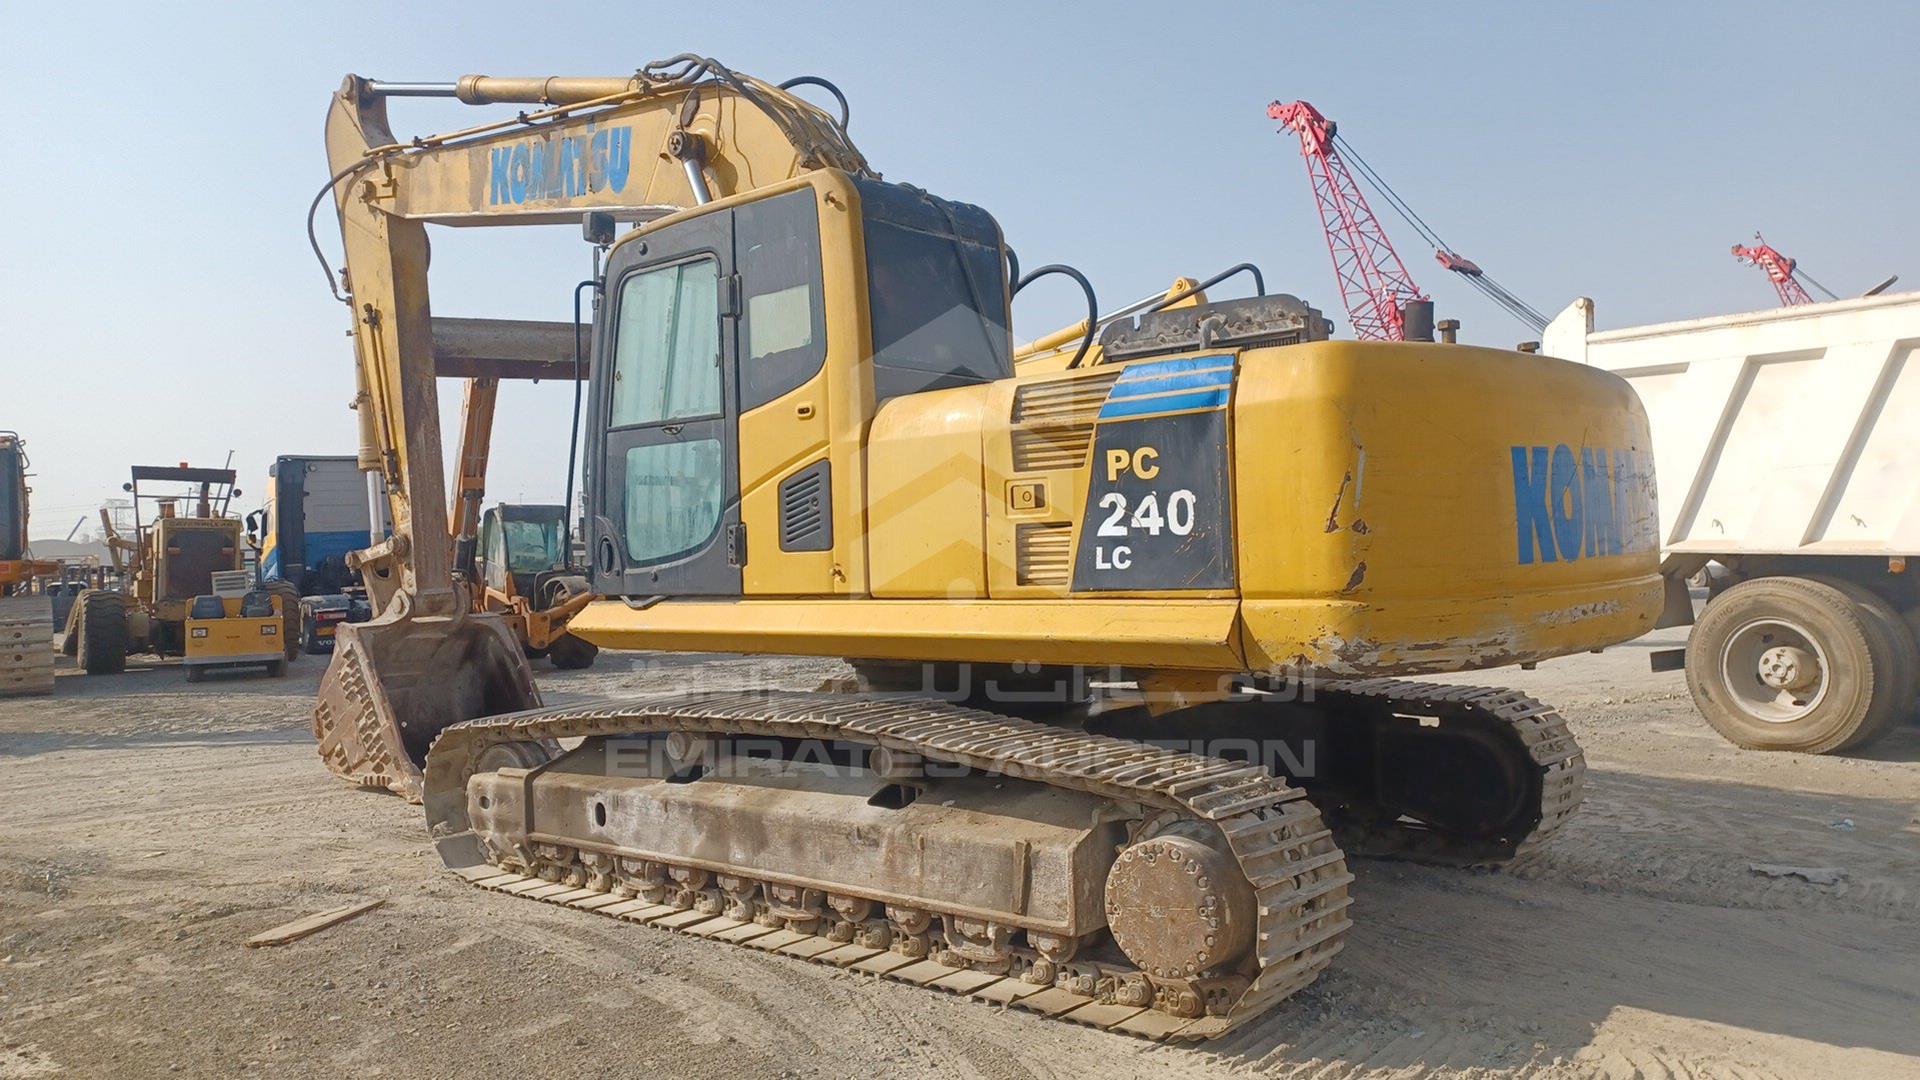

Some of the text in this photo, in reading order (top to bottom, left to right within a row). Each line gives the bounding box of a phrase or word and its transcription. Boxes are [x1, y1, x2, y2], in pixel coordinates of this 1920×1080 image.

[1107, 447, 1160, 481] PC
[1097, 489, 1196, 536] 240
[1095, 546, 1132, 570] LC
